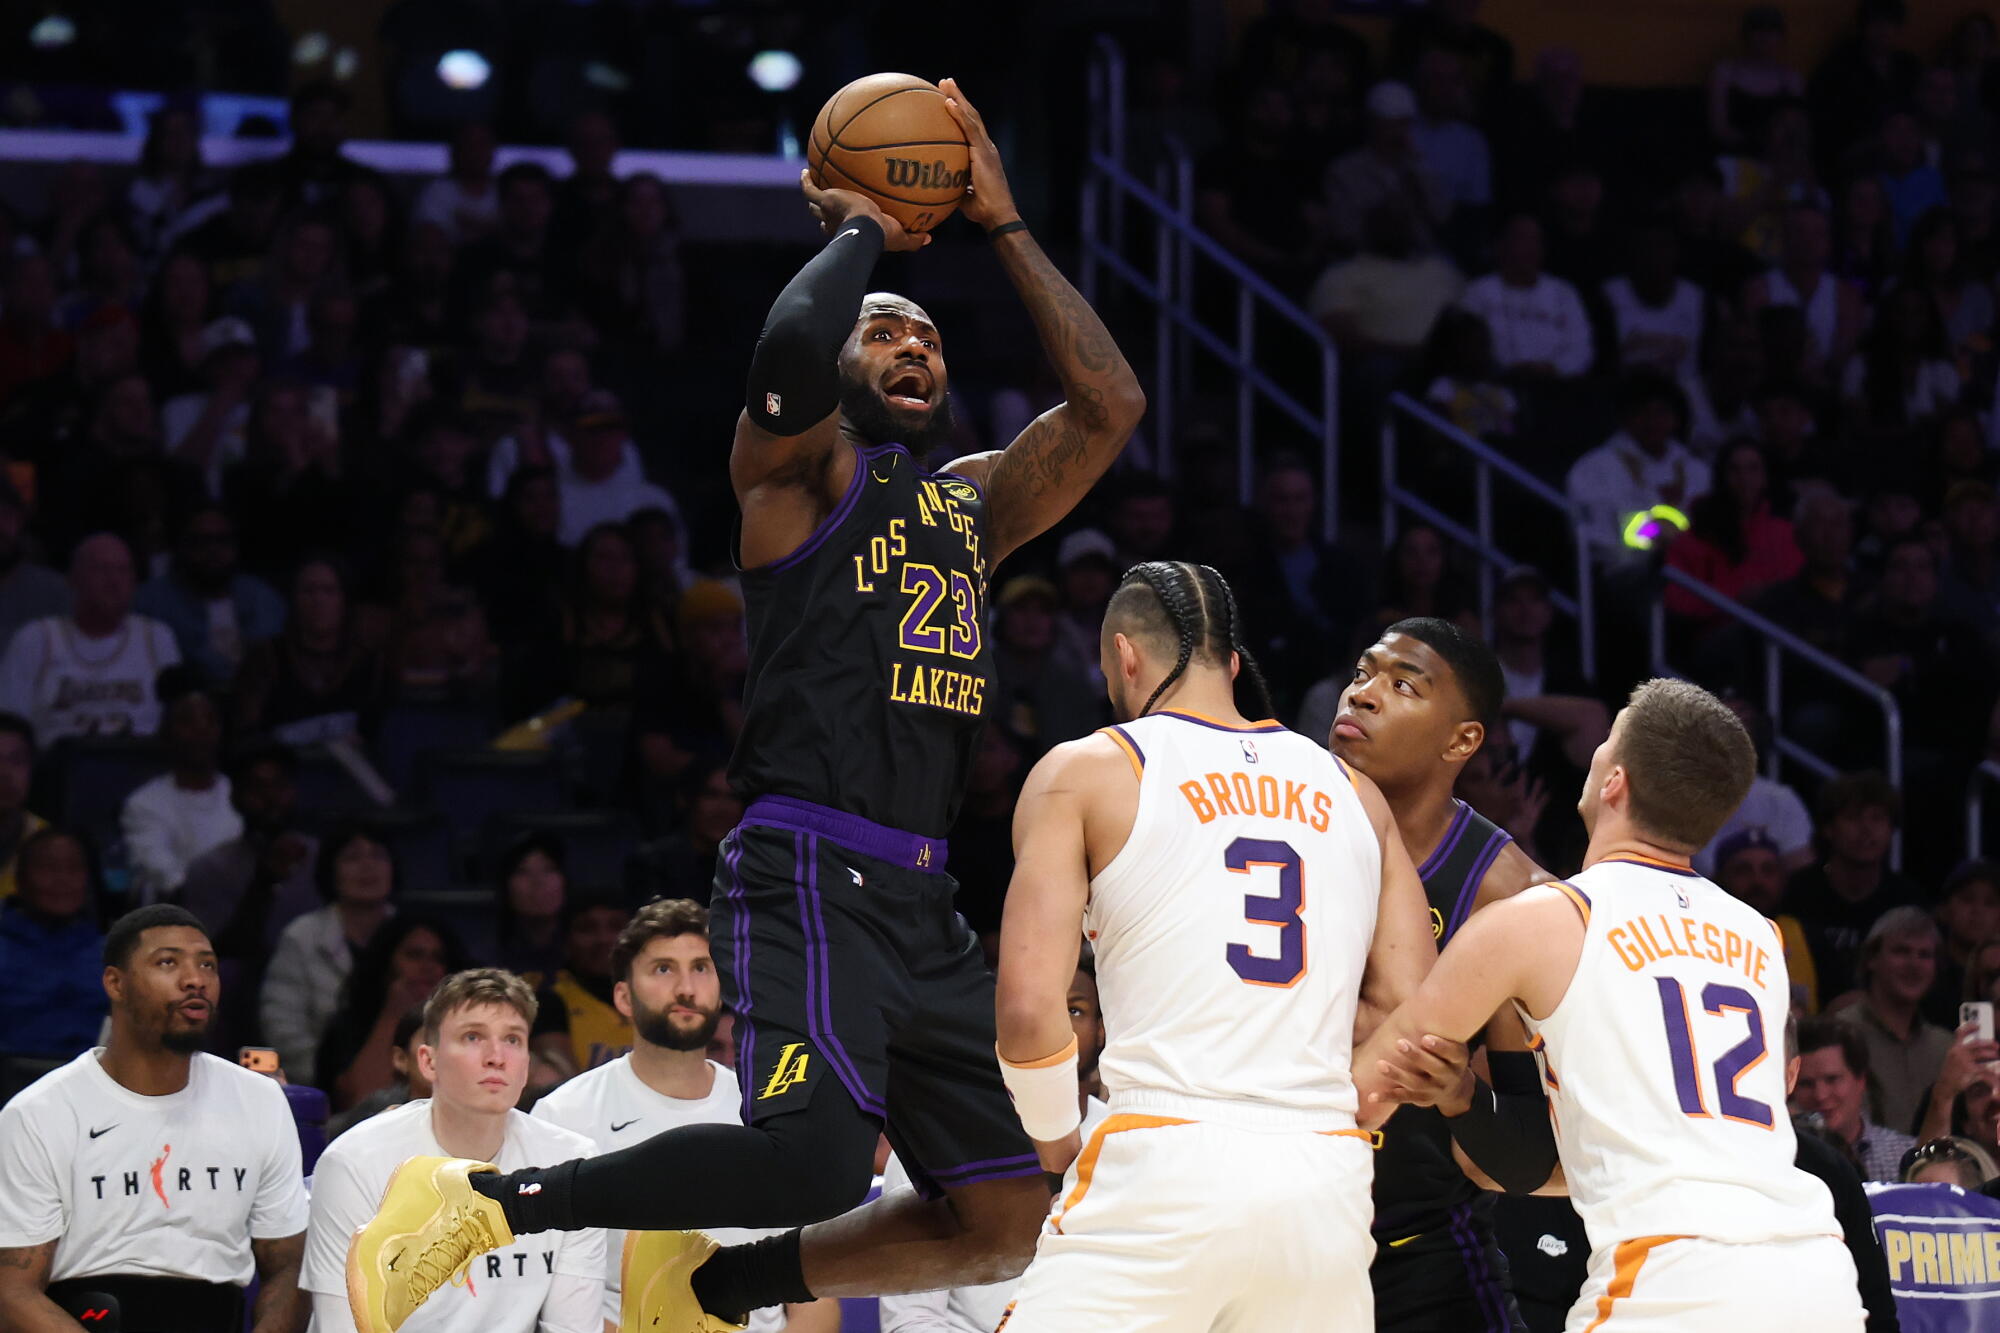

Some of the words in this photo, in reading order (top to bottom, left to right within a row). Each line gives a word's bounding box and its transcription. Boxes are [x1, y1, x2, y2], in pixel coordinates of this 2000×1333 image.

[853, 516, 908, 593] LOS
[915, 479, 988, 618] ANGELE
[899, 562, 983, 661] 23
[889, 662, 987, 716] LAKERS
[1178, 771, 1333, 834] BROOKS
[1223, 836, 1308, 989] 3
[1606, 913, 1770, 990] GILLESPIE
[757, 1042, 810, 1100] LA
[1653, 976, 1775, 1131] 12
[1885, 1229, 2000, 1285] PRIME
